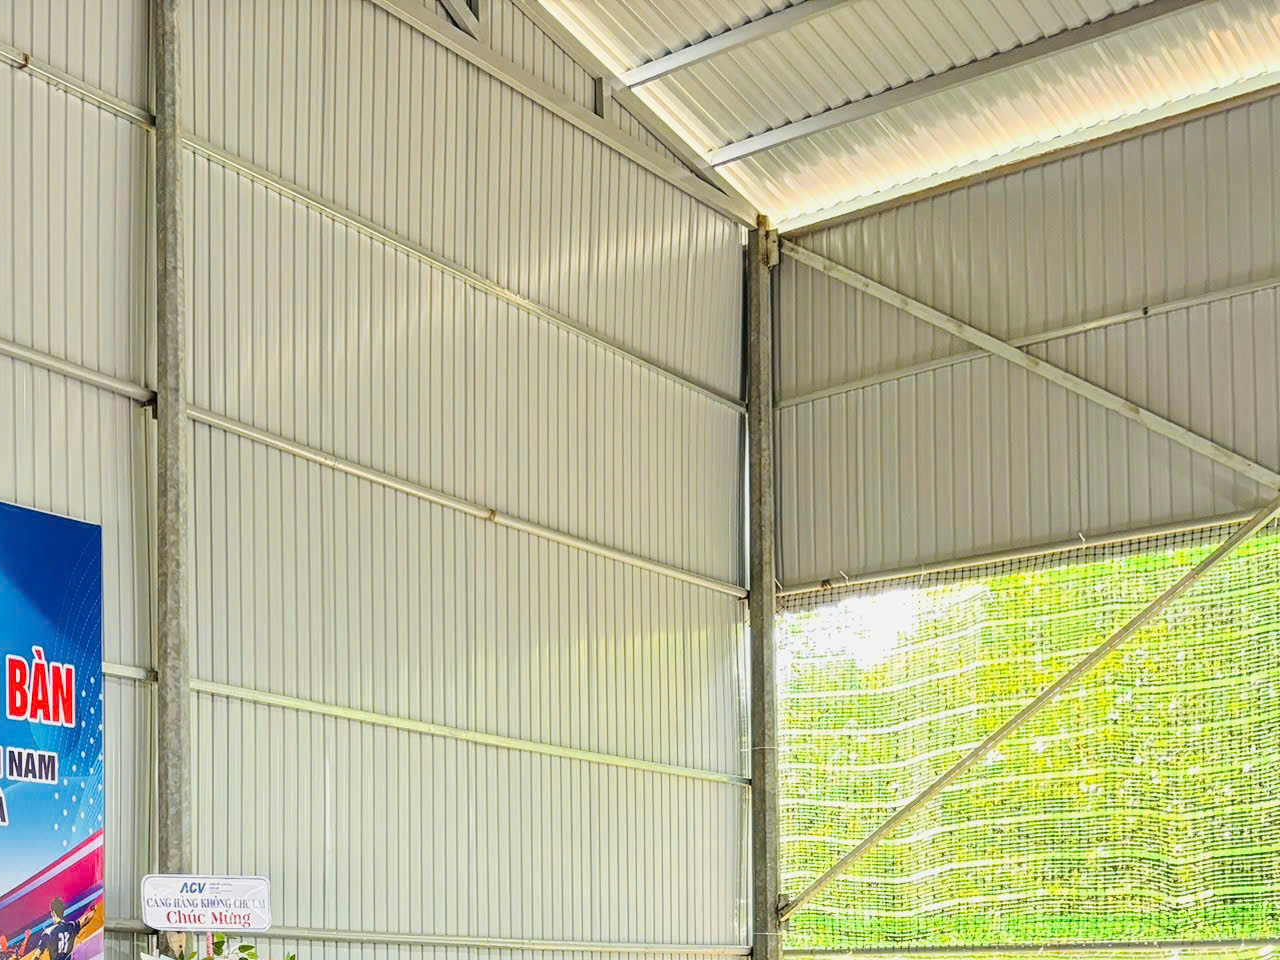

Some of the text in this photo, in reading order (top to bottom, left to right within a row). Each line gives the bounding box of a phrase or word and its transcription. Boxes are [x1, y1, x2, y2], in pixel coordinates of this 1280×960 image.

[8, 649, 76, 726] BÀN
[8, 749, 57, 782] NAM
[179, 882, 207, 894] ACV
[166, 909, 252, 928] Chúc Mừng
